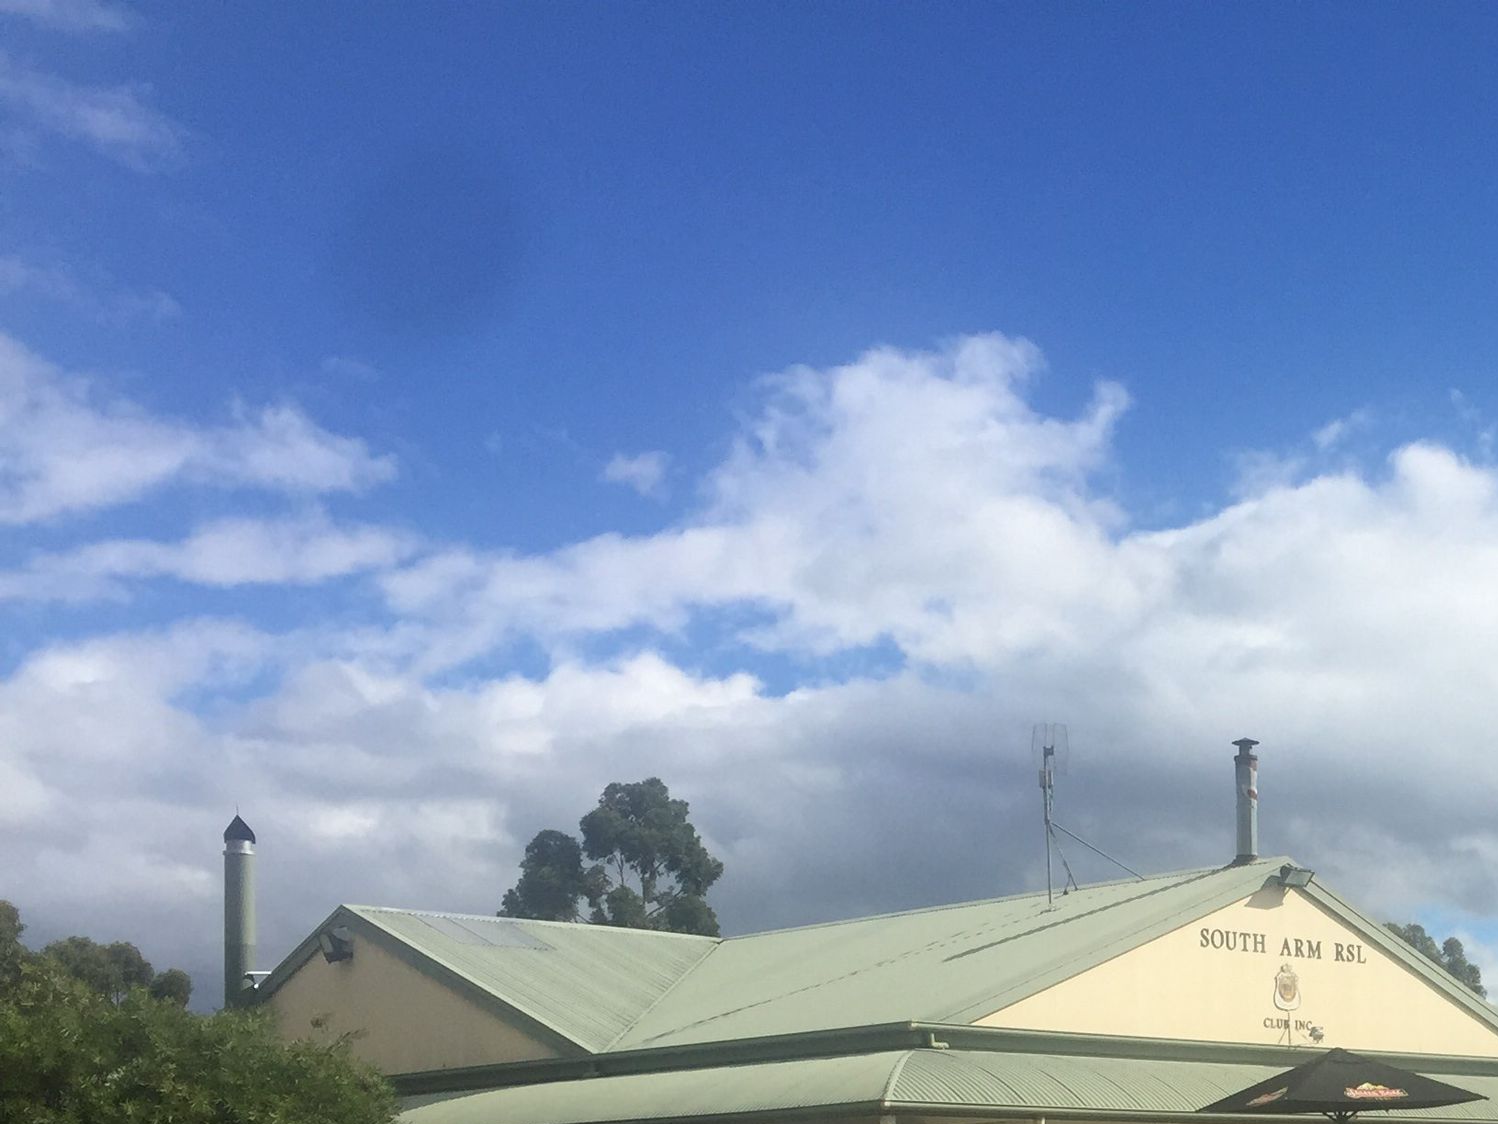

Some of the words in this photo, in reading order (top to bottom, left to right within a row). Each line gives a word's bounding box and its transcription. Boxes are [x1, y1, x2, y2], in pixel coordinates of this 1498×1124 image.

[1199, 927, 1267, 954] SOUTH
[1279, 937, 1322, 960] ARM
[1333, 942, 1367, 964] RSL
[1263, 1017, 1289, 1030] CLUB
